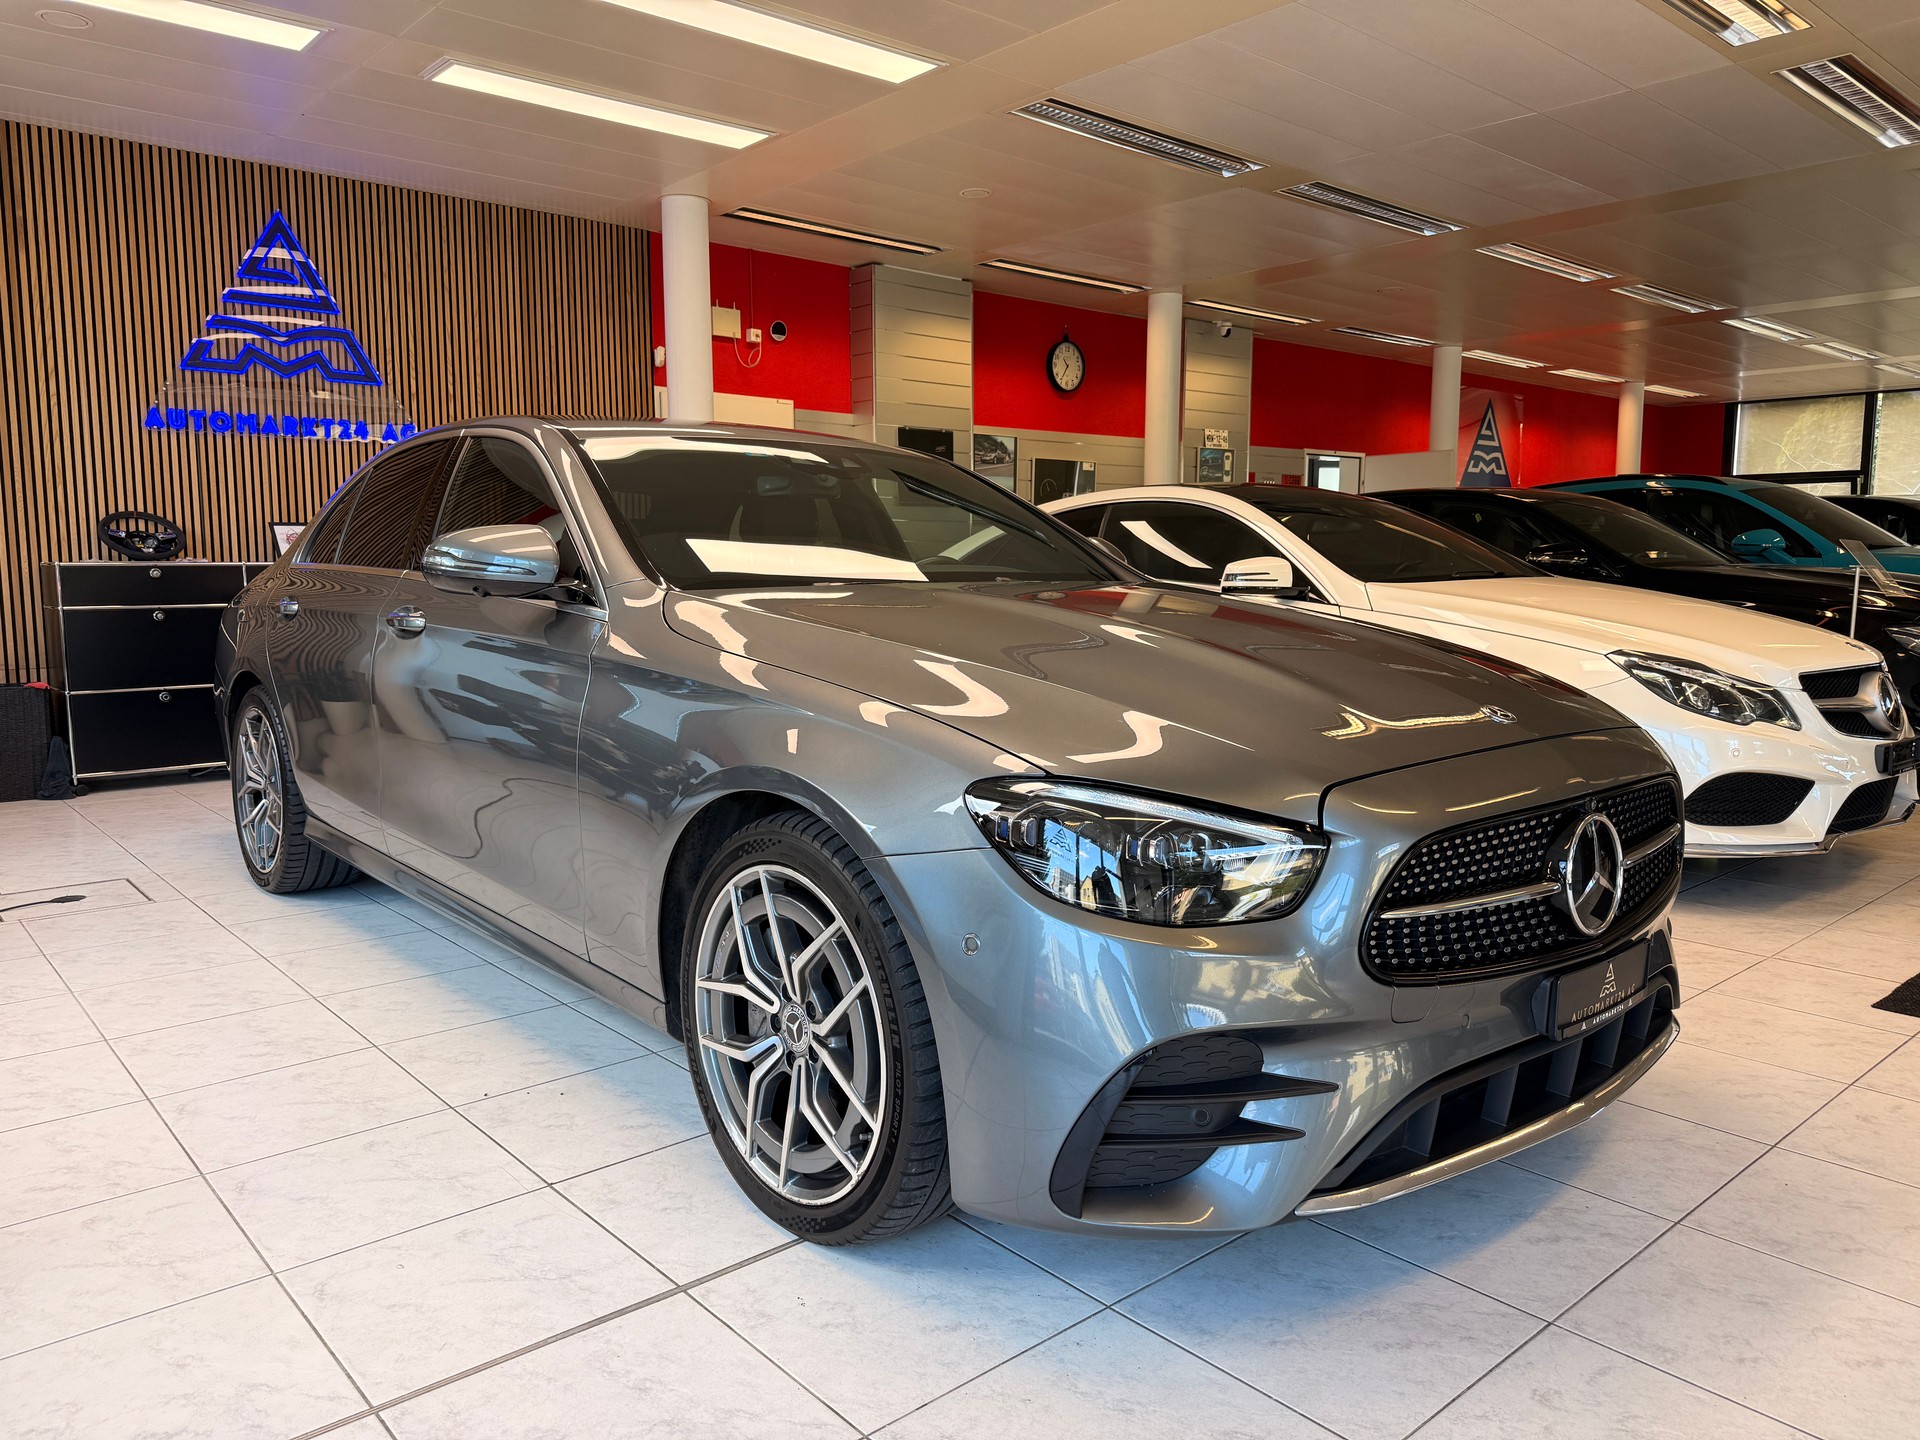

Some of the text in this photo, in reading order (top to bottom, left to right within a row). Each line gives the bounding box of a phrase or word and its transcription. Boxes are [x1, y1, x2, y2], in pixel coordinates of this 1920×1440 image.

[144, 406, 416, 441] AUTOMARKT24 AG
[866, 941, 901, 1048] MICHELIN
[1571, 989, 1625, 1023] AUTOMARKT24
[894, 1060, 902, 1095] PILOT
[891, 1097, 902, 1137] SPORT
